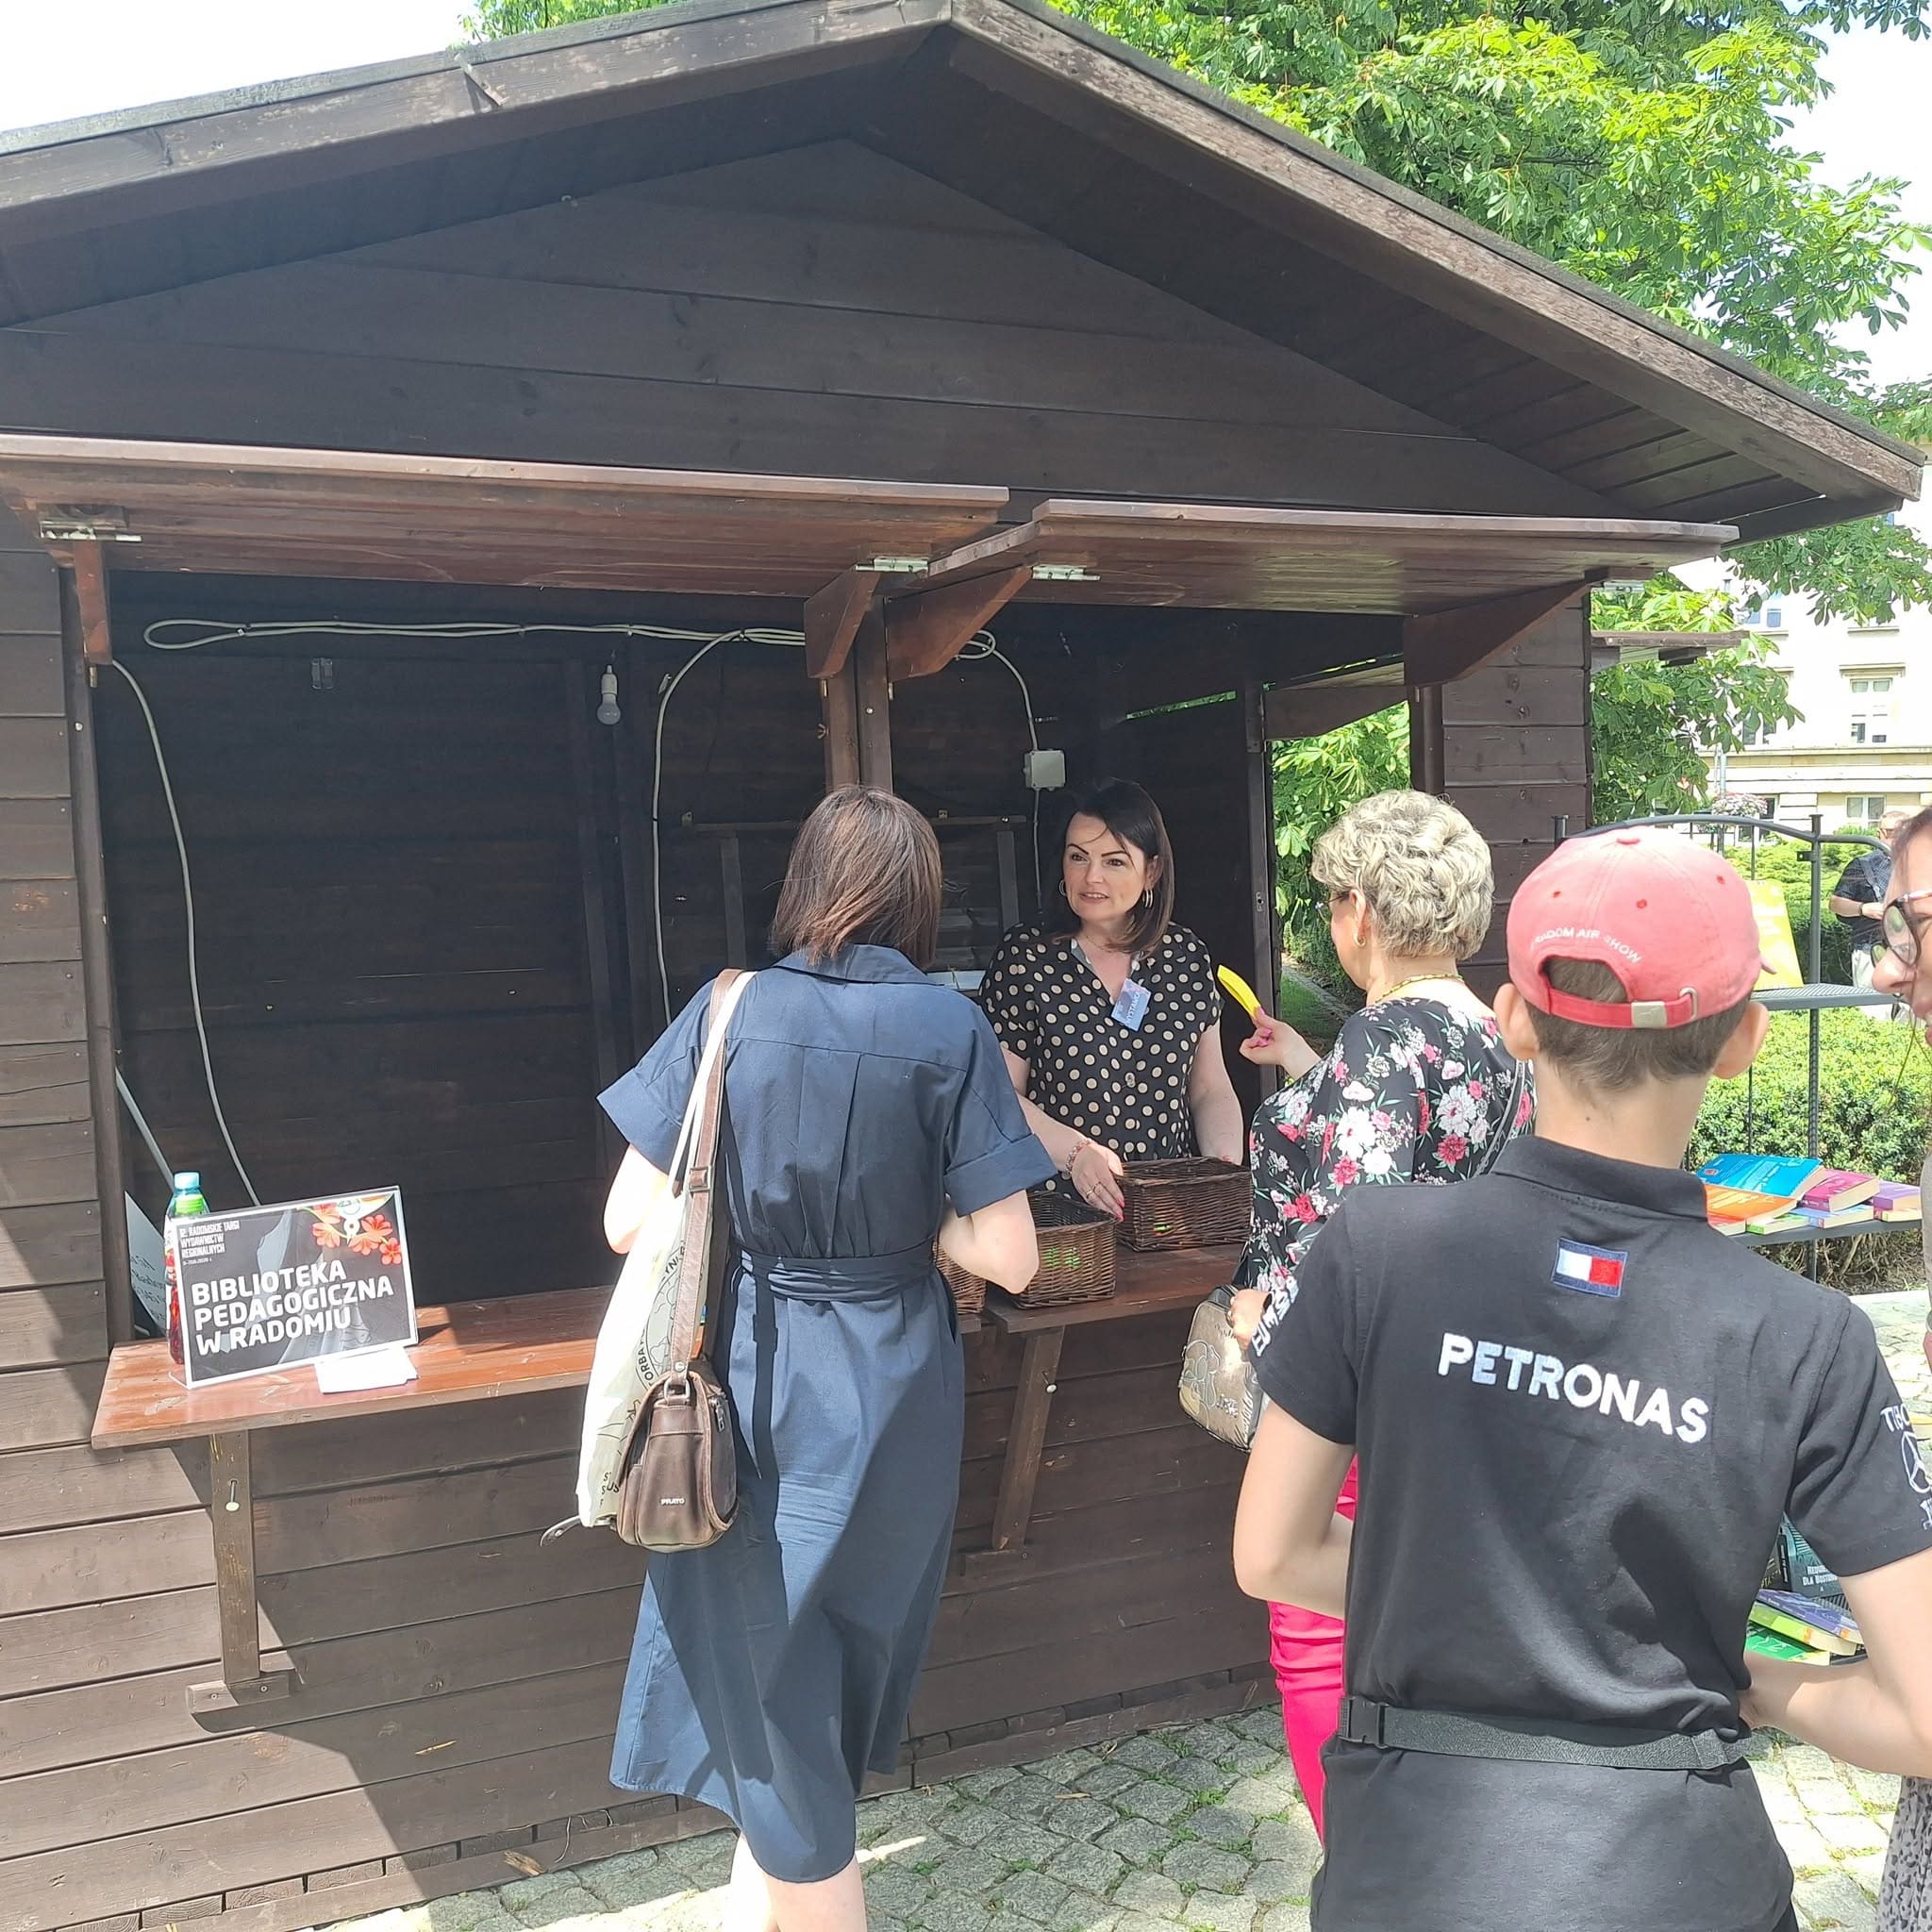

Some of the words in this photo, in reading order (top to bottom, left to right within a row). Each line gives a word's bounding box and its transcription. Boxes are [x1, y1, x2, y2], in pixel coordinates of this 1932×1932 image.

[1575, 928, 1601, 939] AIR
[1604, 935, 1641, 963] SHOW
[191, 1259, 347, 1307] BIBLIOTEKA
[193, 1275, 394, 1331] PEDAGOGICZNA
[195, 1333, 223, 1357] W
[229, 1307, 352, 1350] RADOMIU
[1437, 1332, 1709, 1444] PETRONAS
